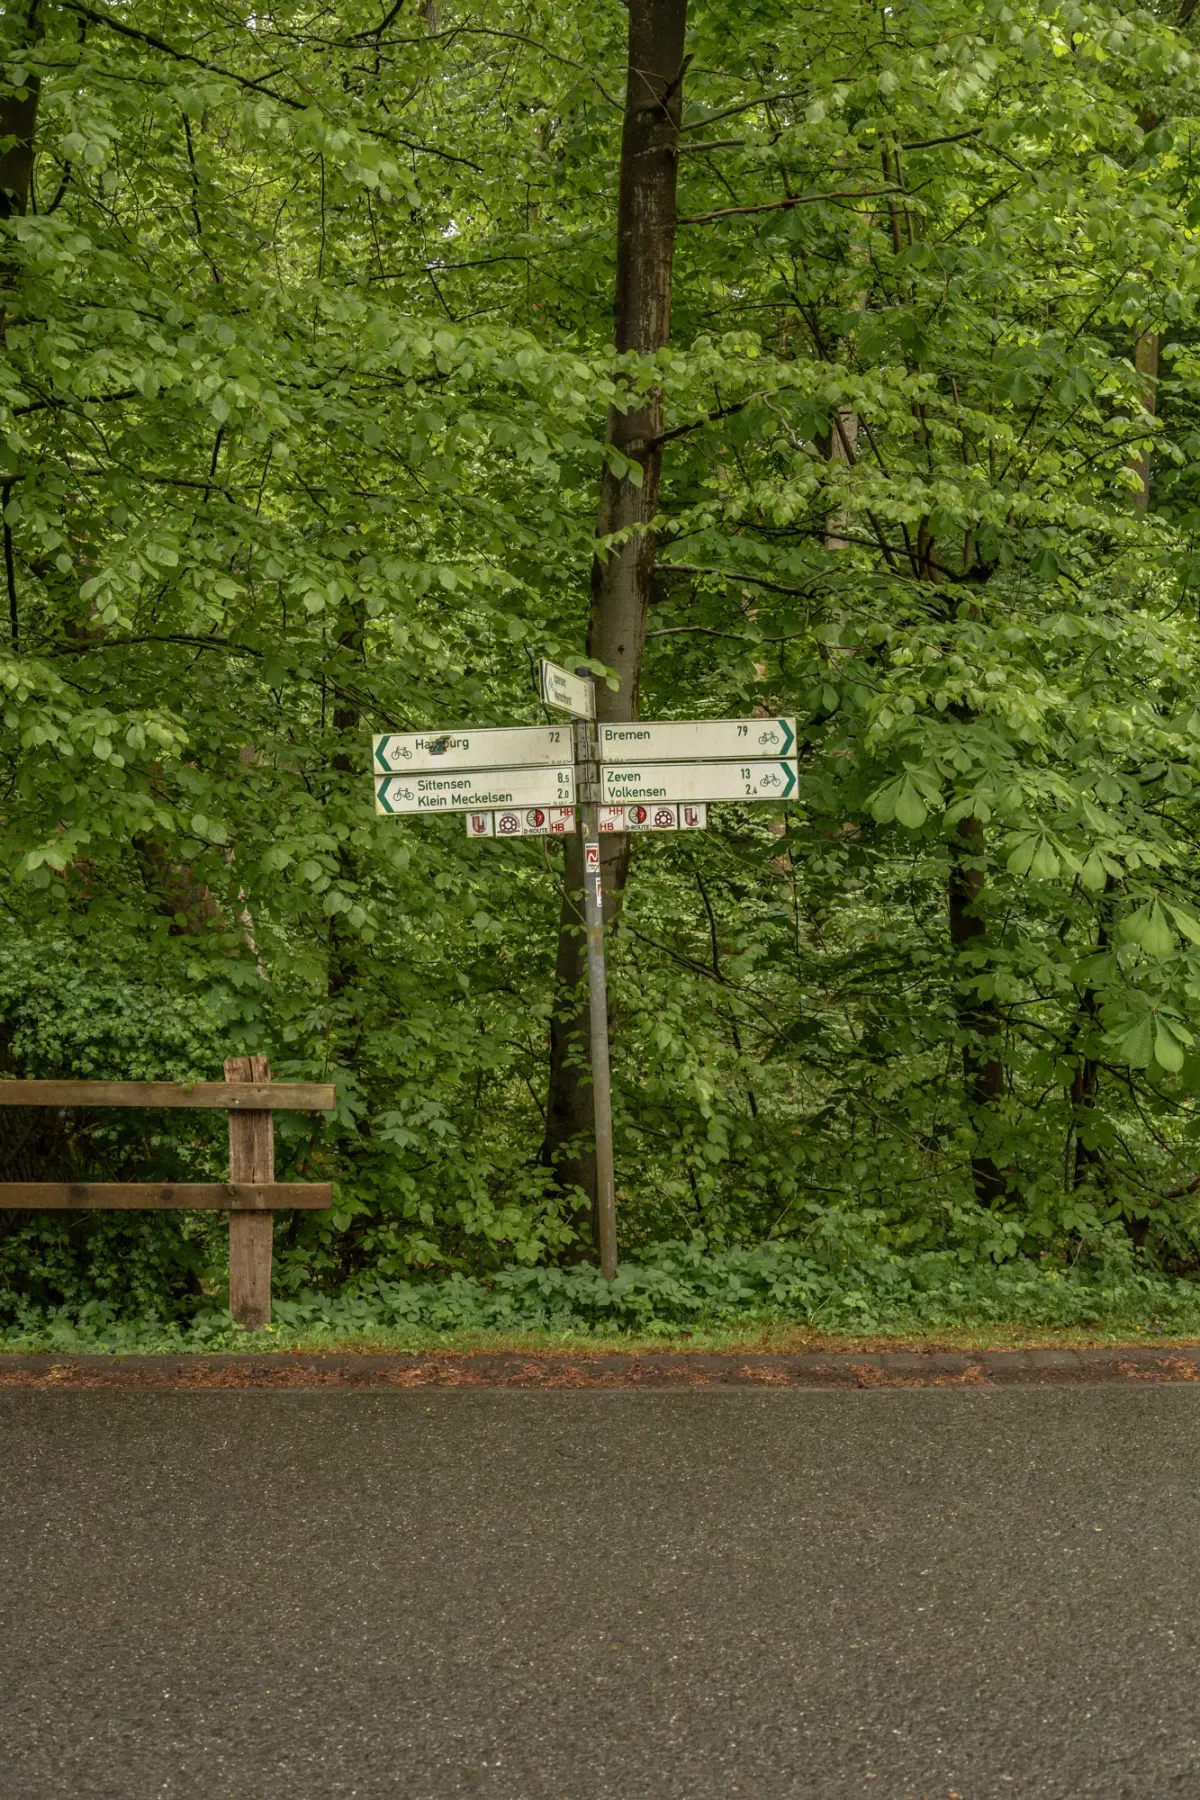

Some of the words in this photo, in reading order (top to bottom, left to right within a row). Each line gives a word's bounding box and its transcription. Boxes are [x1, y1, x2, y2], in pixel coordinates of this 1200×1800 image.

[605, 730, 651, 741] Bremen
[737, 725, 748, 737] 79
[549, 732, 560, 743] 72
[415, 737, 470, 751] Haurg
[607, 771, 641, 782] Zeven
[741, 768, 751, 779] 13
[417, 779, 471, 791] Sittensen
[608, 786, 667, 798] Volkensen
[418, 795, 447, 807] Klein
[451, 792, 513, 805] Meckelsen
[559, 808, 574, 816] HH
[609, 807, 623, 815] HH
[523, 827, 548, 835] D-ROUTE
[550, 823, 565, 832] HB
[599, 822, 614, 831] HB
